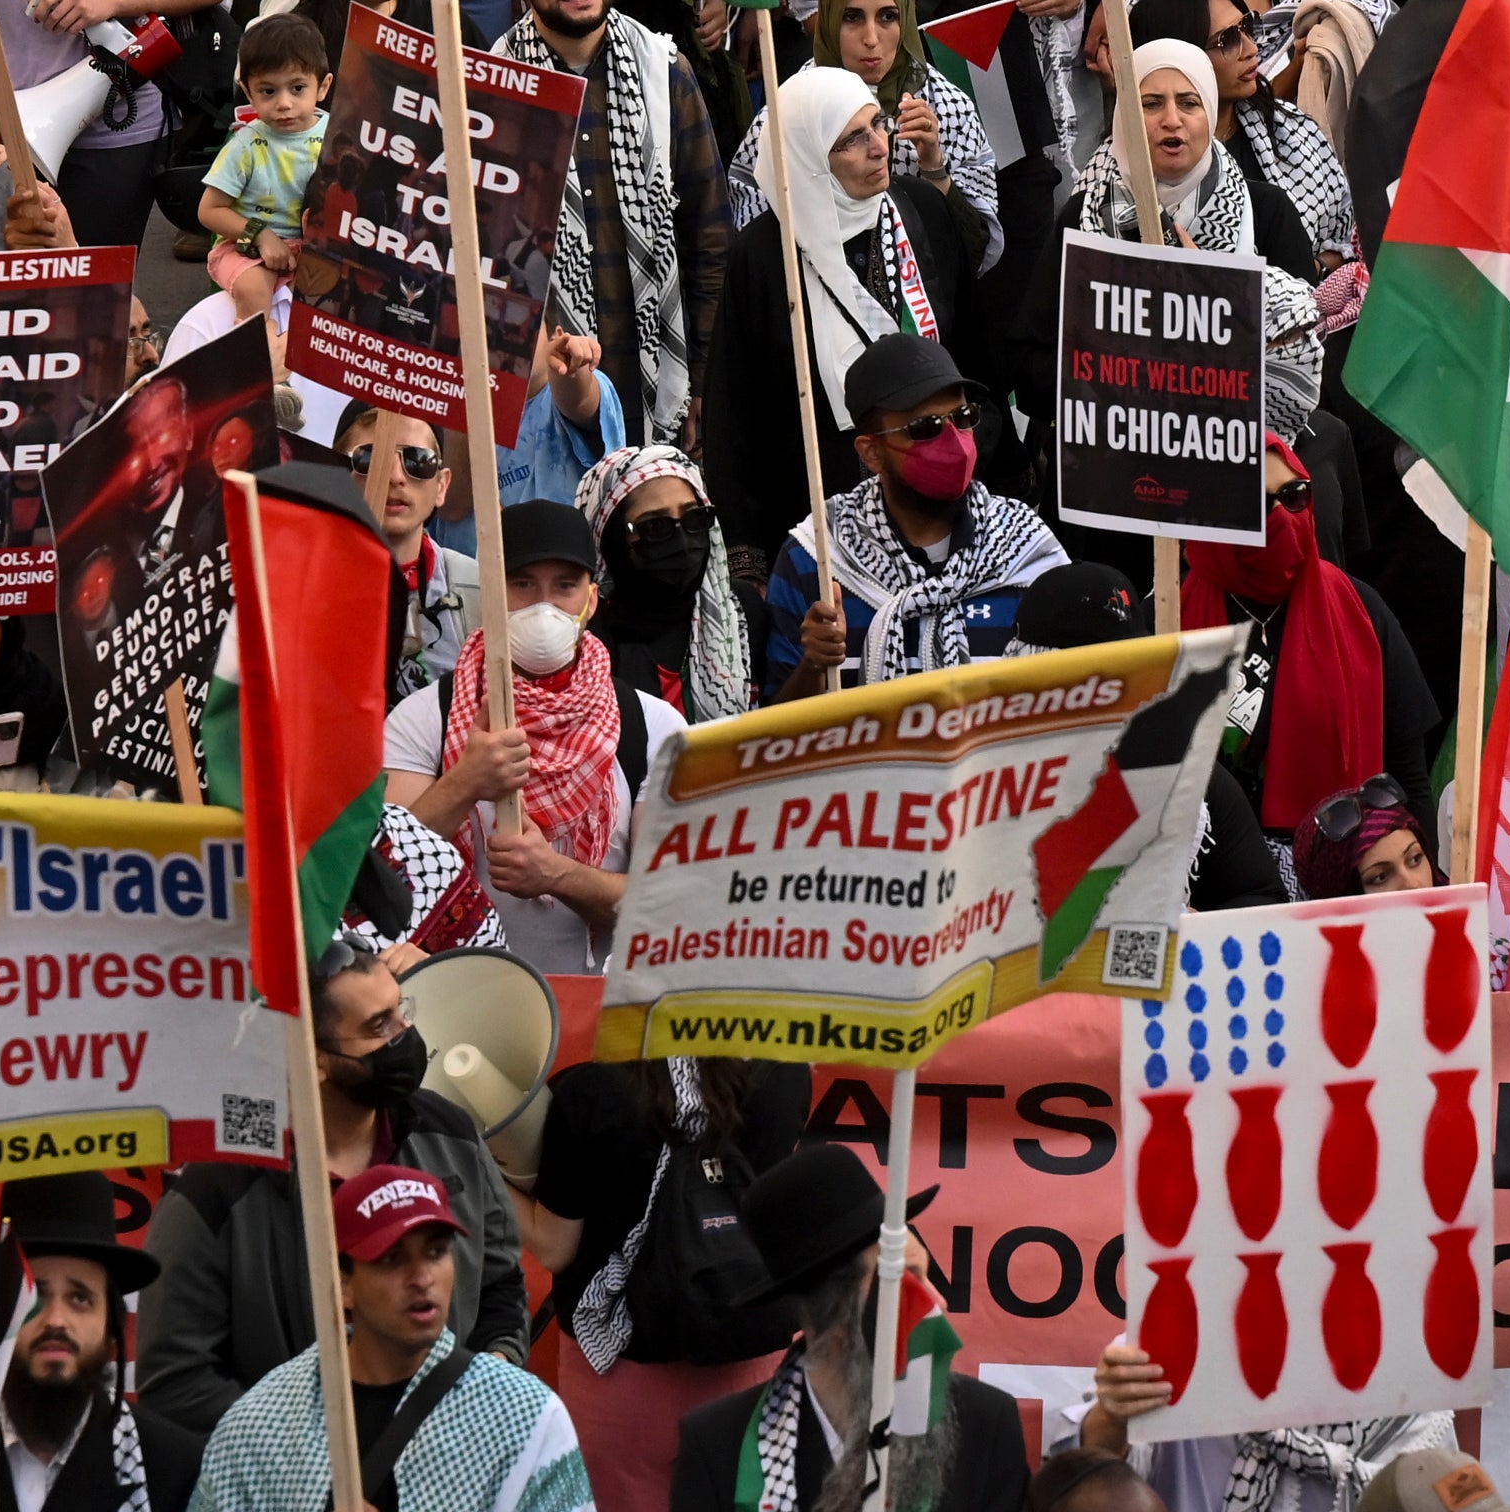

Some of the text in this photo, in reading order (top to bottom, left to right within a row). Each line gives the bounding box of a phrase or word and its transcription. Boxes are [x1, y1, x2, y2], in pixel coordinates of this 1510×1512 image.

[1090, 281, 1232, 345] THE DNC
[1073, 350, 1249, 400] IS NOT WELCOME
[1064, 399, 1257, 465] IN CHICAGO!
[737, 675, 1124, 769] Torah Demands
[645, 756, 1068, 873] ALL PALESTINE
[728, 869, 956, 908] be returned to
[626, 887, 1014, 970] Palestinian Sovereignty
[669, 989, 975, 1053] www.nkusa.org
[356, 1179, 440, 1221] VENEZIA
